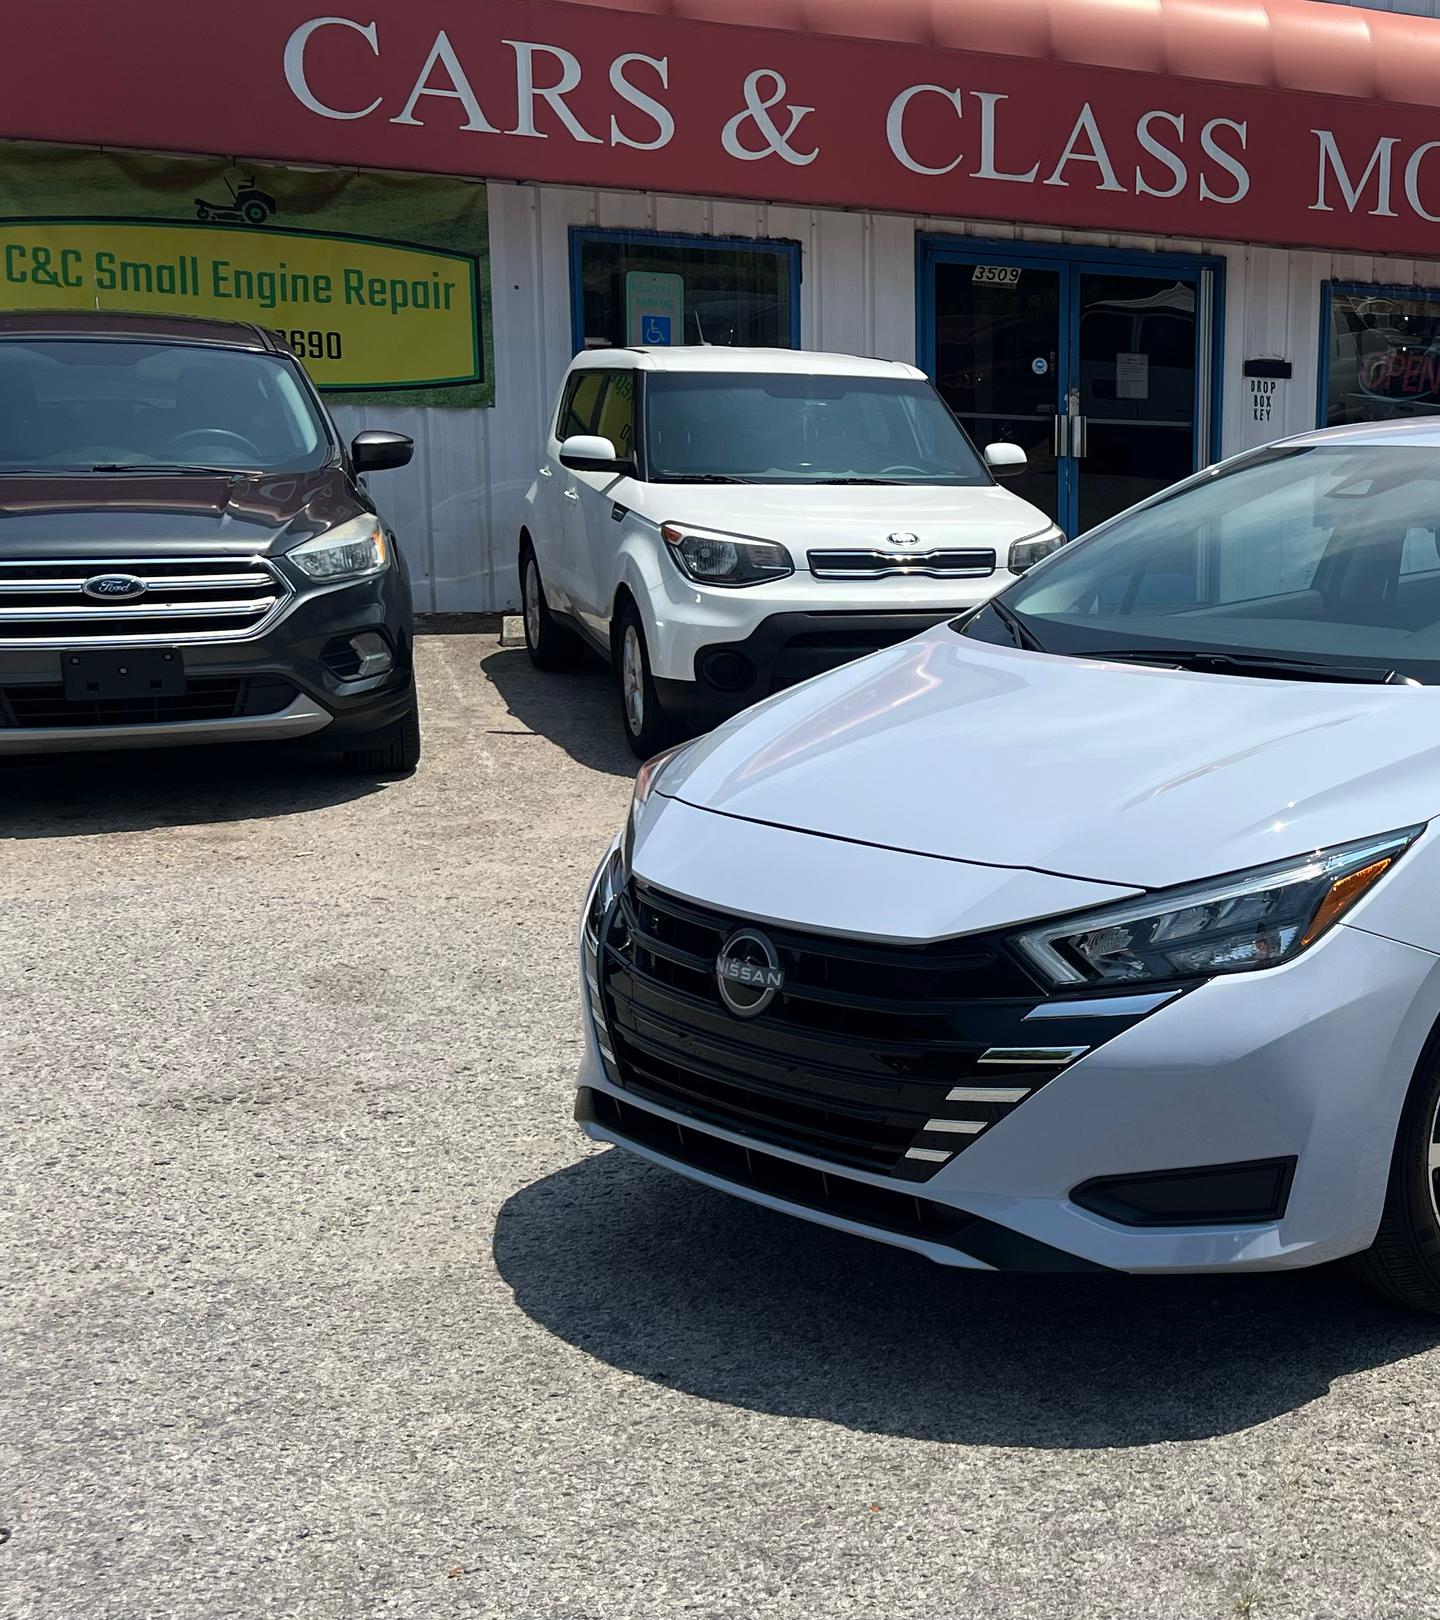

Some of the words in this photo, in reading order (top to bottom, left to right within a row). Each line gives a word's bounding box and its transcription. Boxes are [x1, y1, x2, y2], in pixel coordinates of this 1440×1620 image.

[284, 17, 675, 151] CARS
[721, 69, 820, 166] &
[886, 84, 1250, 204] CLASS
[5, 244, 83, 288] C&C
[95, 251, 200, 297] Small
[212, 260, 333, 309] Engine
[343, 268, 456, 314] Repair
[975, 266, 1019, 281] 3509
[1251, 380, 1276, 394] DROP
[1253, 395, 1271, 408] BOX
[1253, 408, 1271, 421] KEY
[98, 580, 131, 592] Ford
[716, 956, 782, 986] NISSAN
